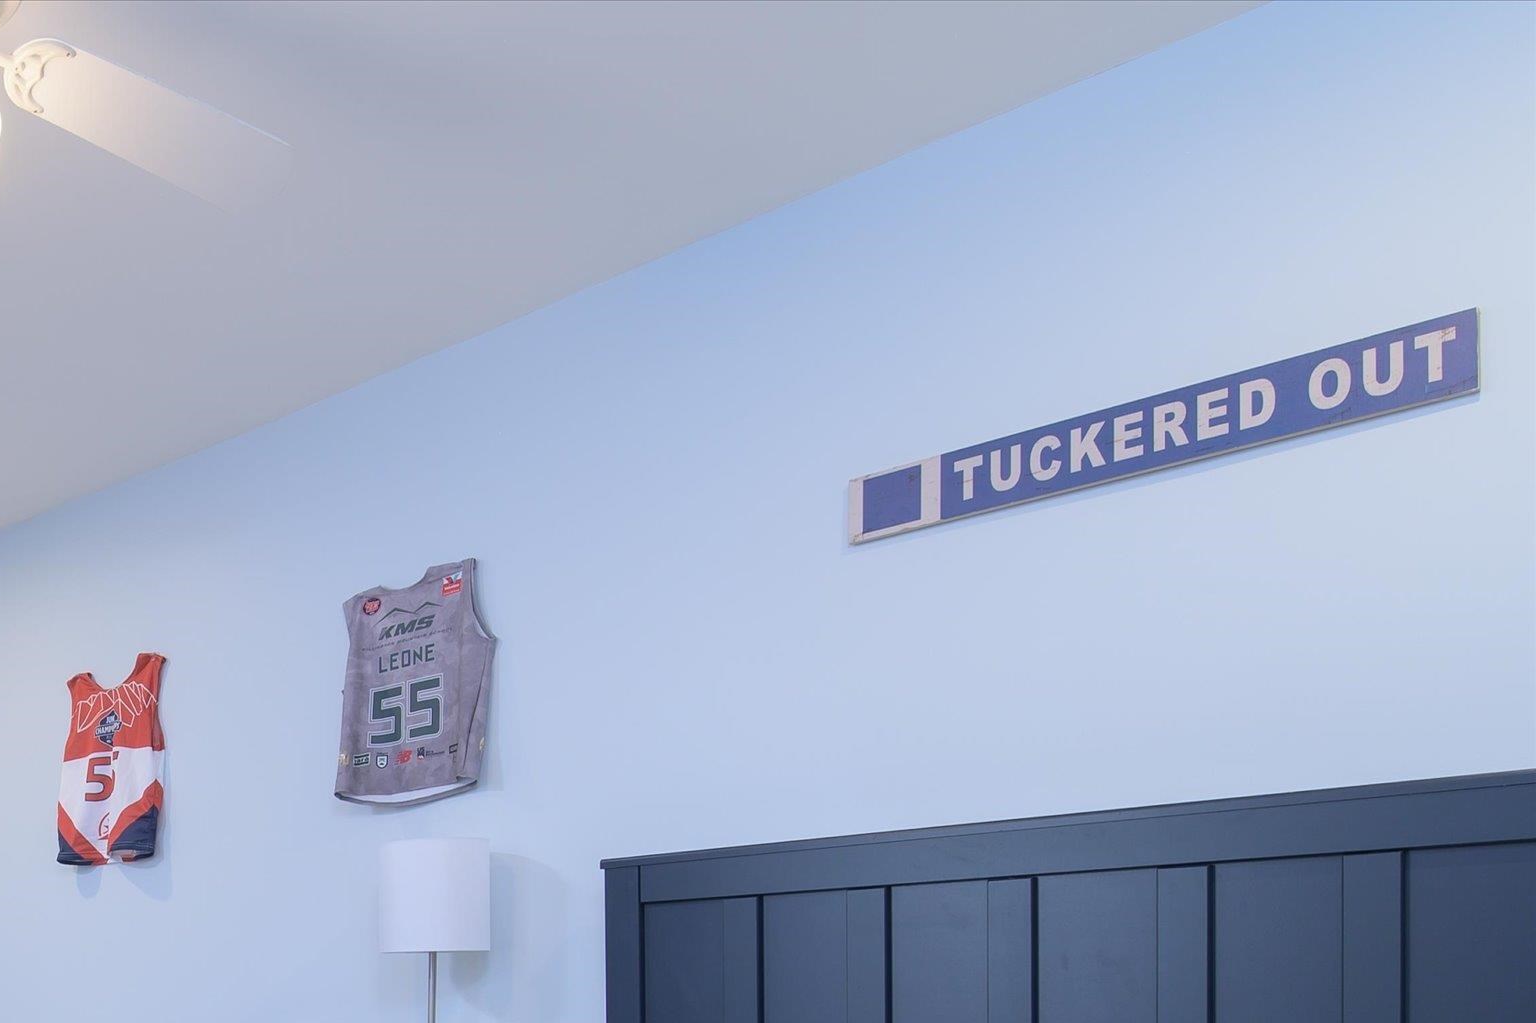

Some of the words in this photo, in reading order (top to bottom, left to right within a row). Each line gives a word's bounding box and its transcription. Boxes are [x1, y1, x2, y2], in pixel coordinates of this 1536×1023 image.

[953, 378, 1277, 501] TUCKERED
[1308, 326, 1457, 411] OUT
[378, 614, 436, 641] KMS
[378, 643, 435, 674] LEONE
[367, 673, 443, 748] 55
